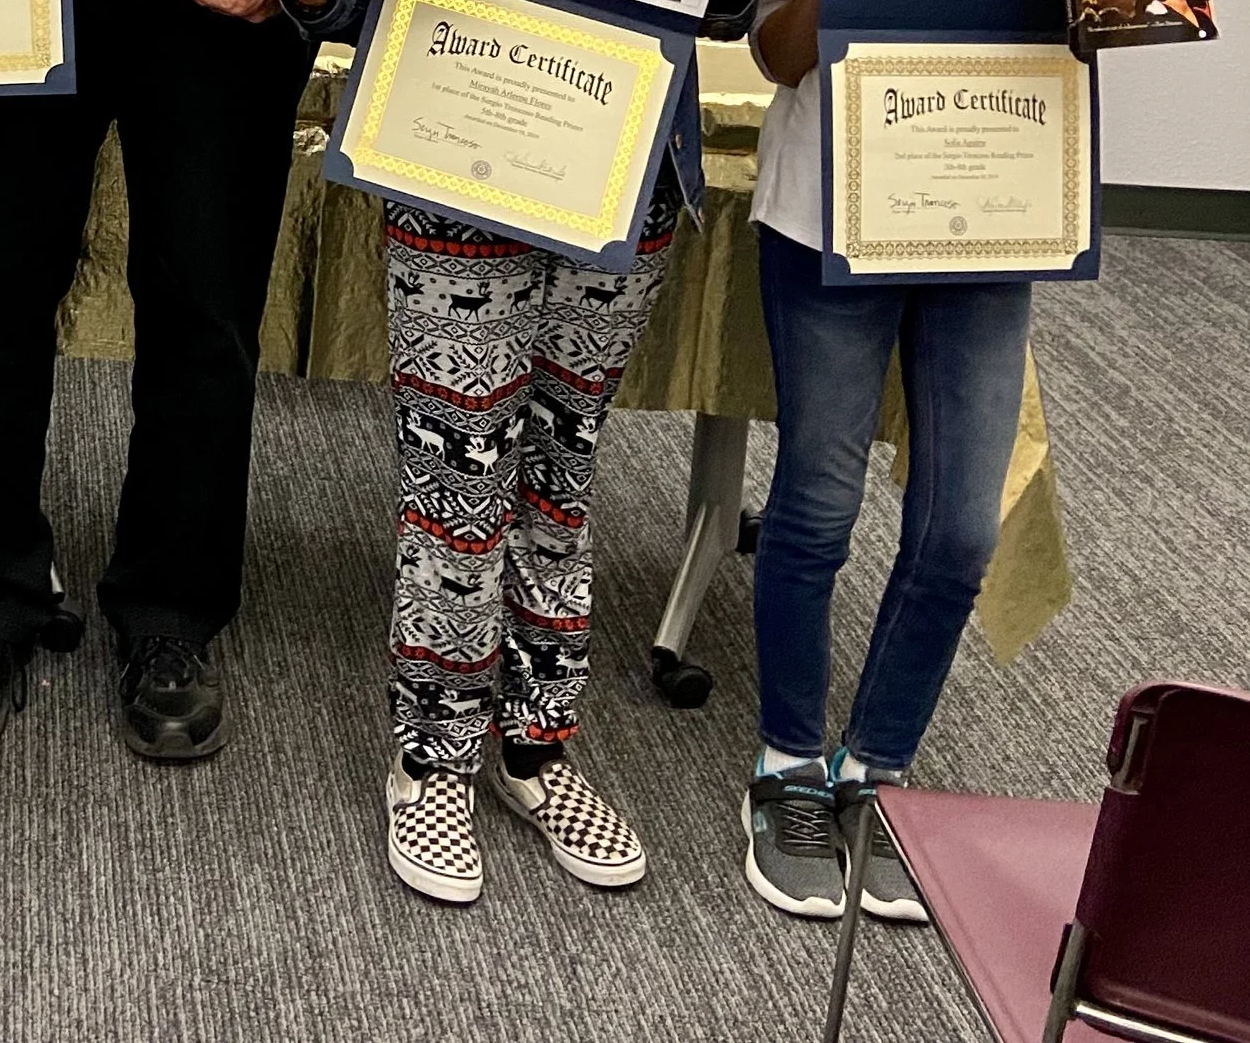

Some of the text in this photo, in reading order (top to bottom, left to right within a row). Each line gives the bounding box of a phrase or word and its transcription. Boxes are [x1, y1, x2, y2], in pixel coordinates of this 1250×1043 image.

[427, 21, 613, 106] Award Certificate
[454, 62, 469, 72] This
[471, 67, 494, 79] Award
[502, 76, 530, 90] proudly
[531, 85, 566, 100] presented
[441, 86, 459, 96] place
[461, 90, 468, 98] of
[469, 93, 479, 101] the
[480, 96, 502, 108] Sergio
[503, 103, 533, 116] Troncoso
[534, 113, 561, 125] Reading
[884, 88, 1047, 129] Award Certificate
[507, 116, 527, 127] grade
[911, 125, 926, 133] This
[927, 125, 947, 133] Award
[956, 125, 980, 134] proudly
[943, 152, 962, 160] Sergio
[991, 152, 1015, 160] Reading
[968, 163, 986, 172] grade
